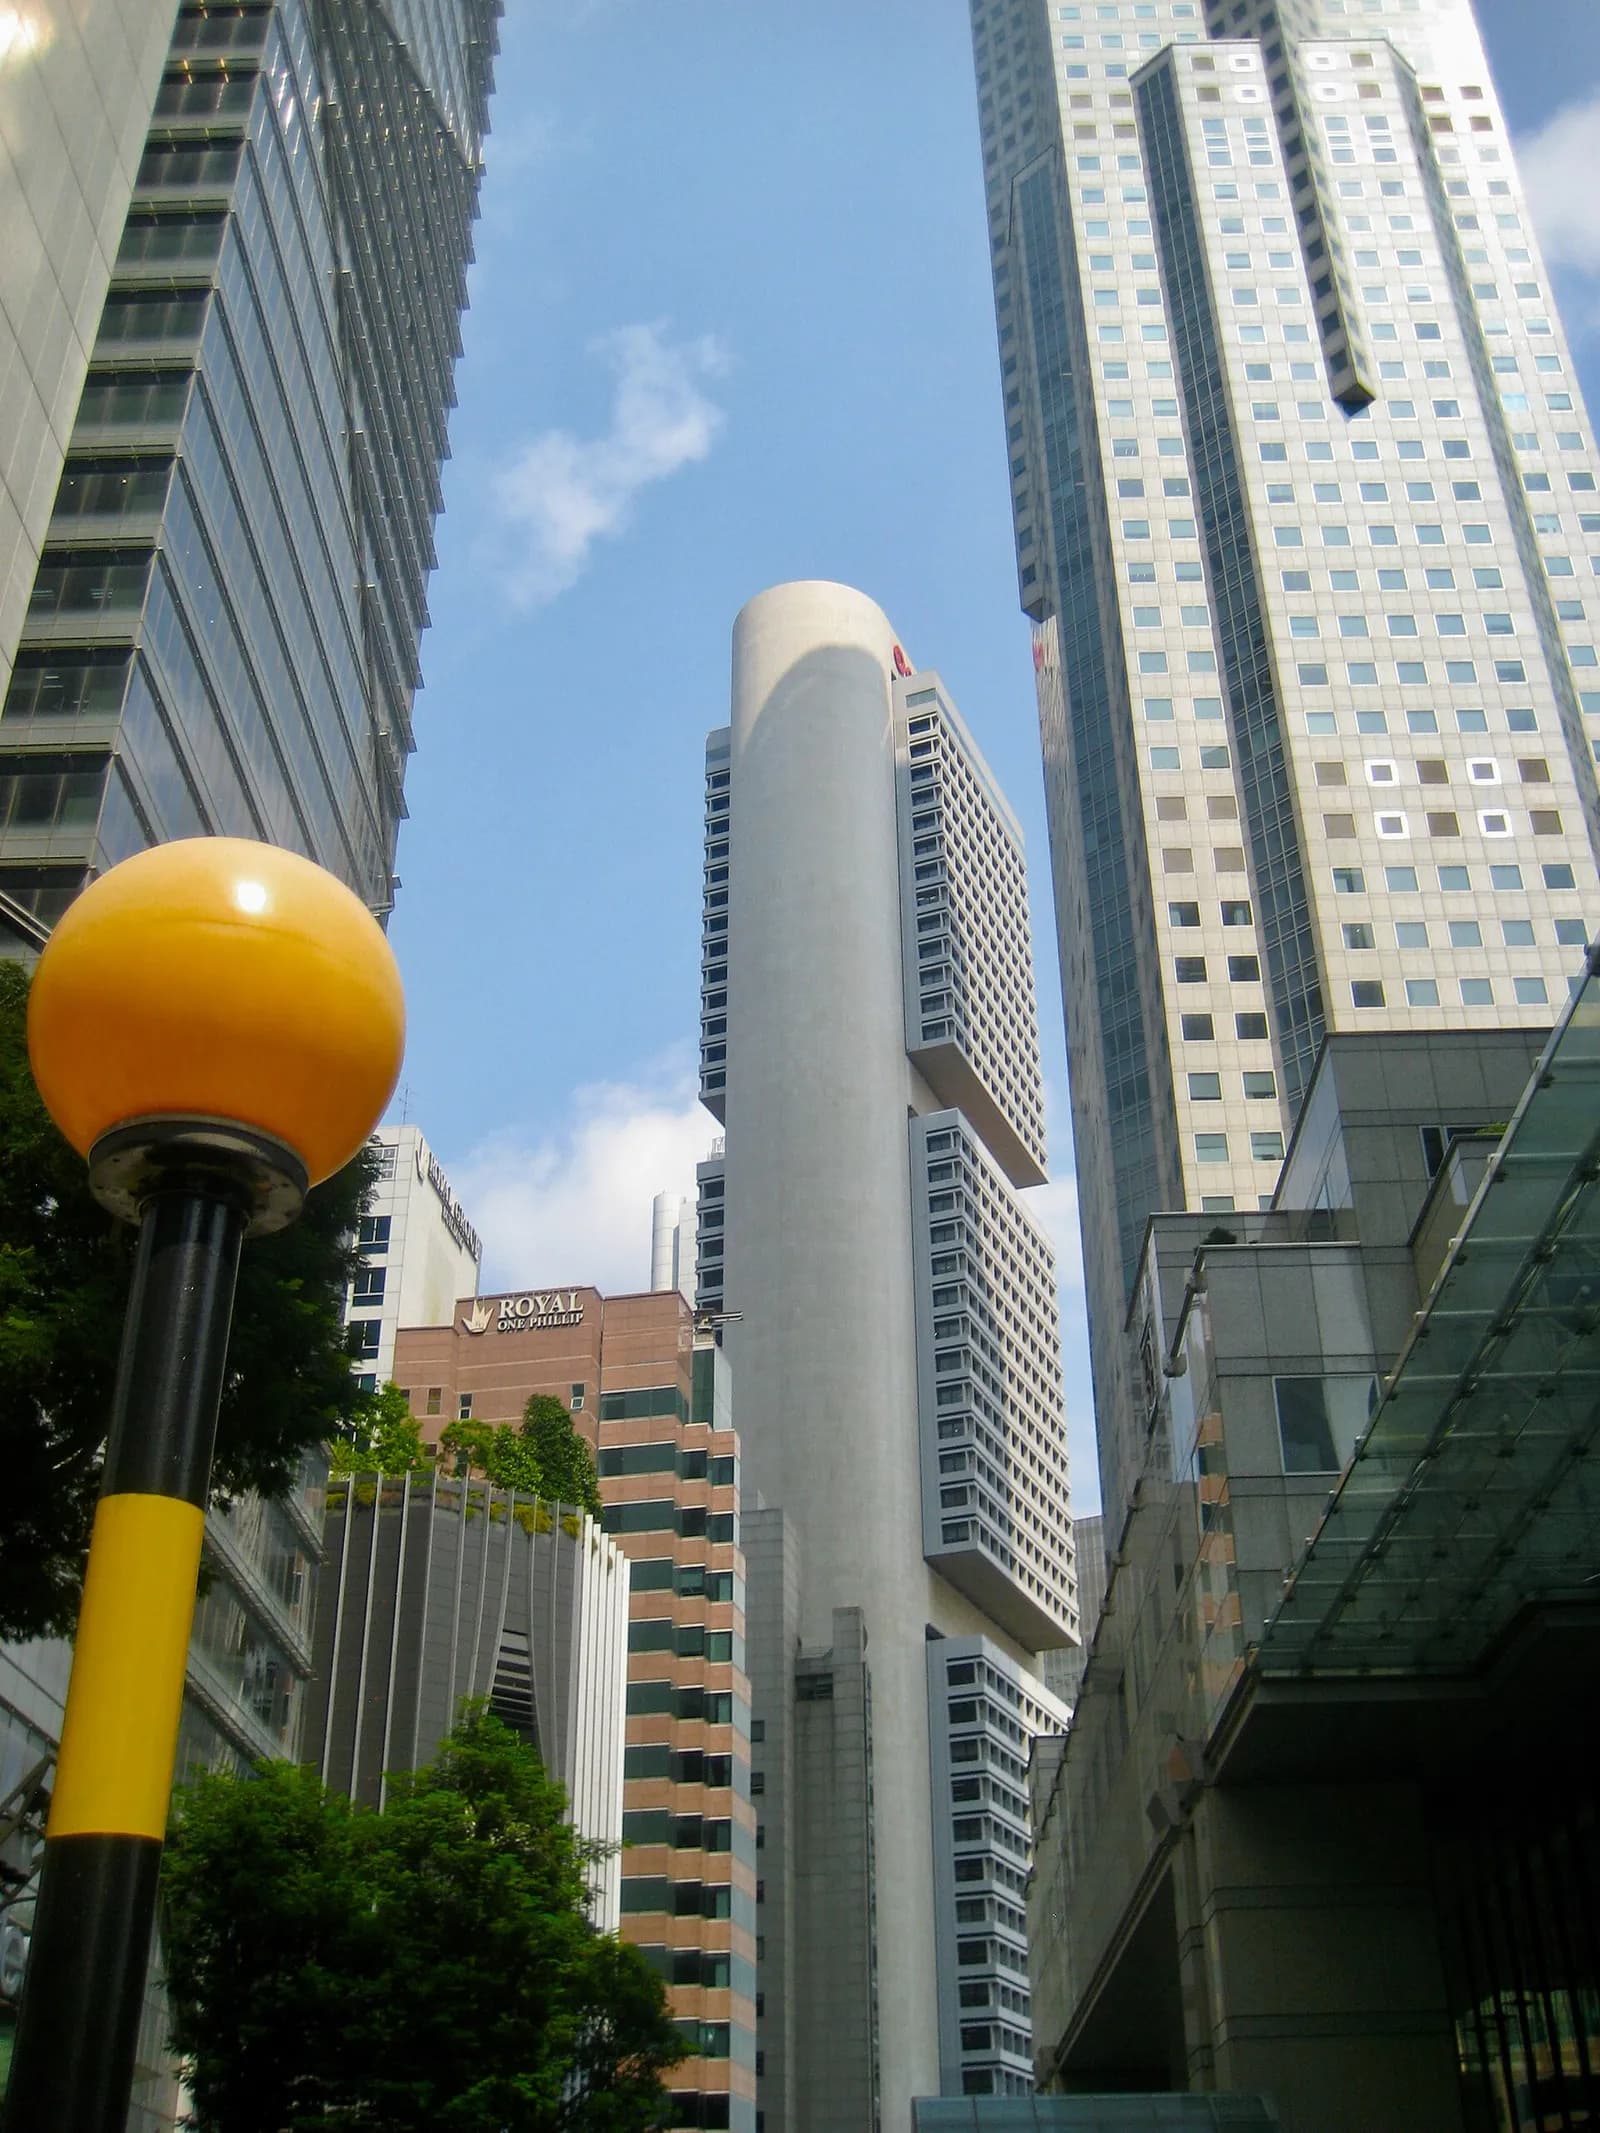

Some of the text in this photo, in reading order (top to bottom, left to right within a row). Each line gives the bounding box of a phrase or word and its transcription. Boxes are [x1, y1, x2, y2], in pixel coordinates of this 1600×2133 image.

[498, 1292, 584, 1320] ROYAL
[497, 1312, 584, 1332] ONE PHILLIP
